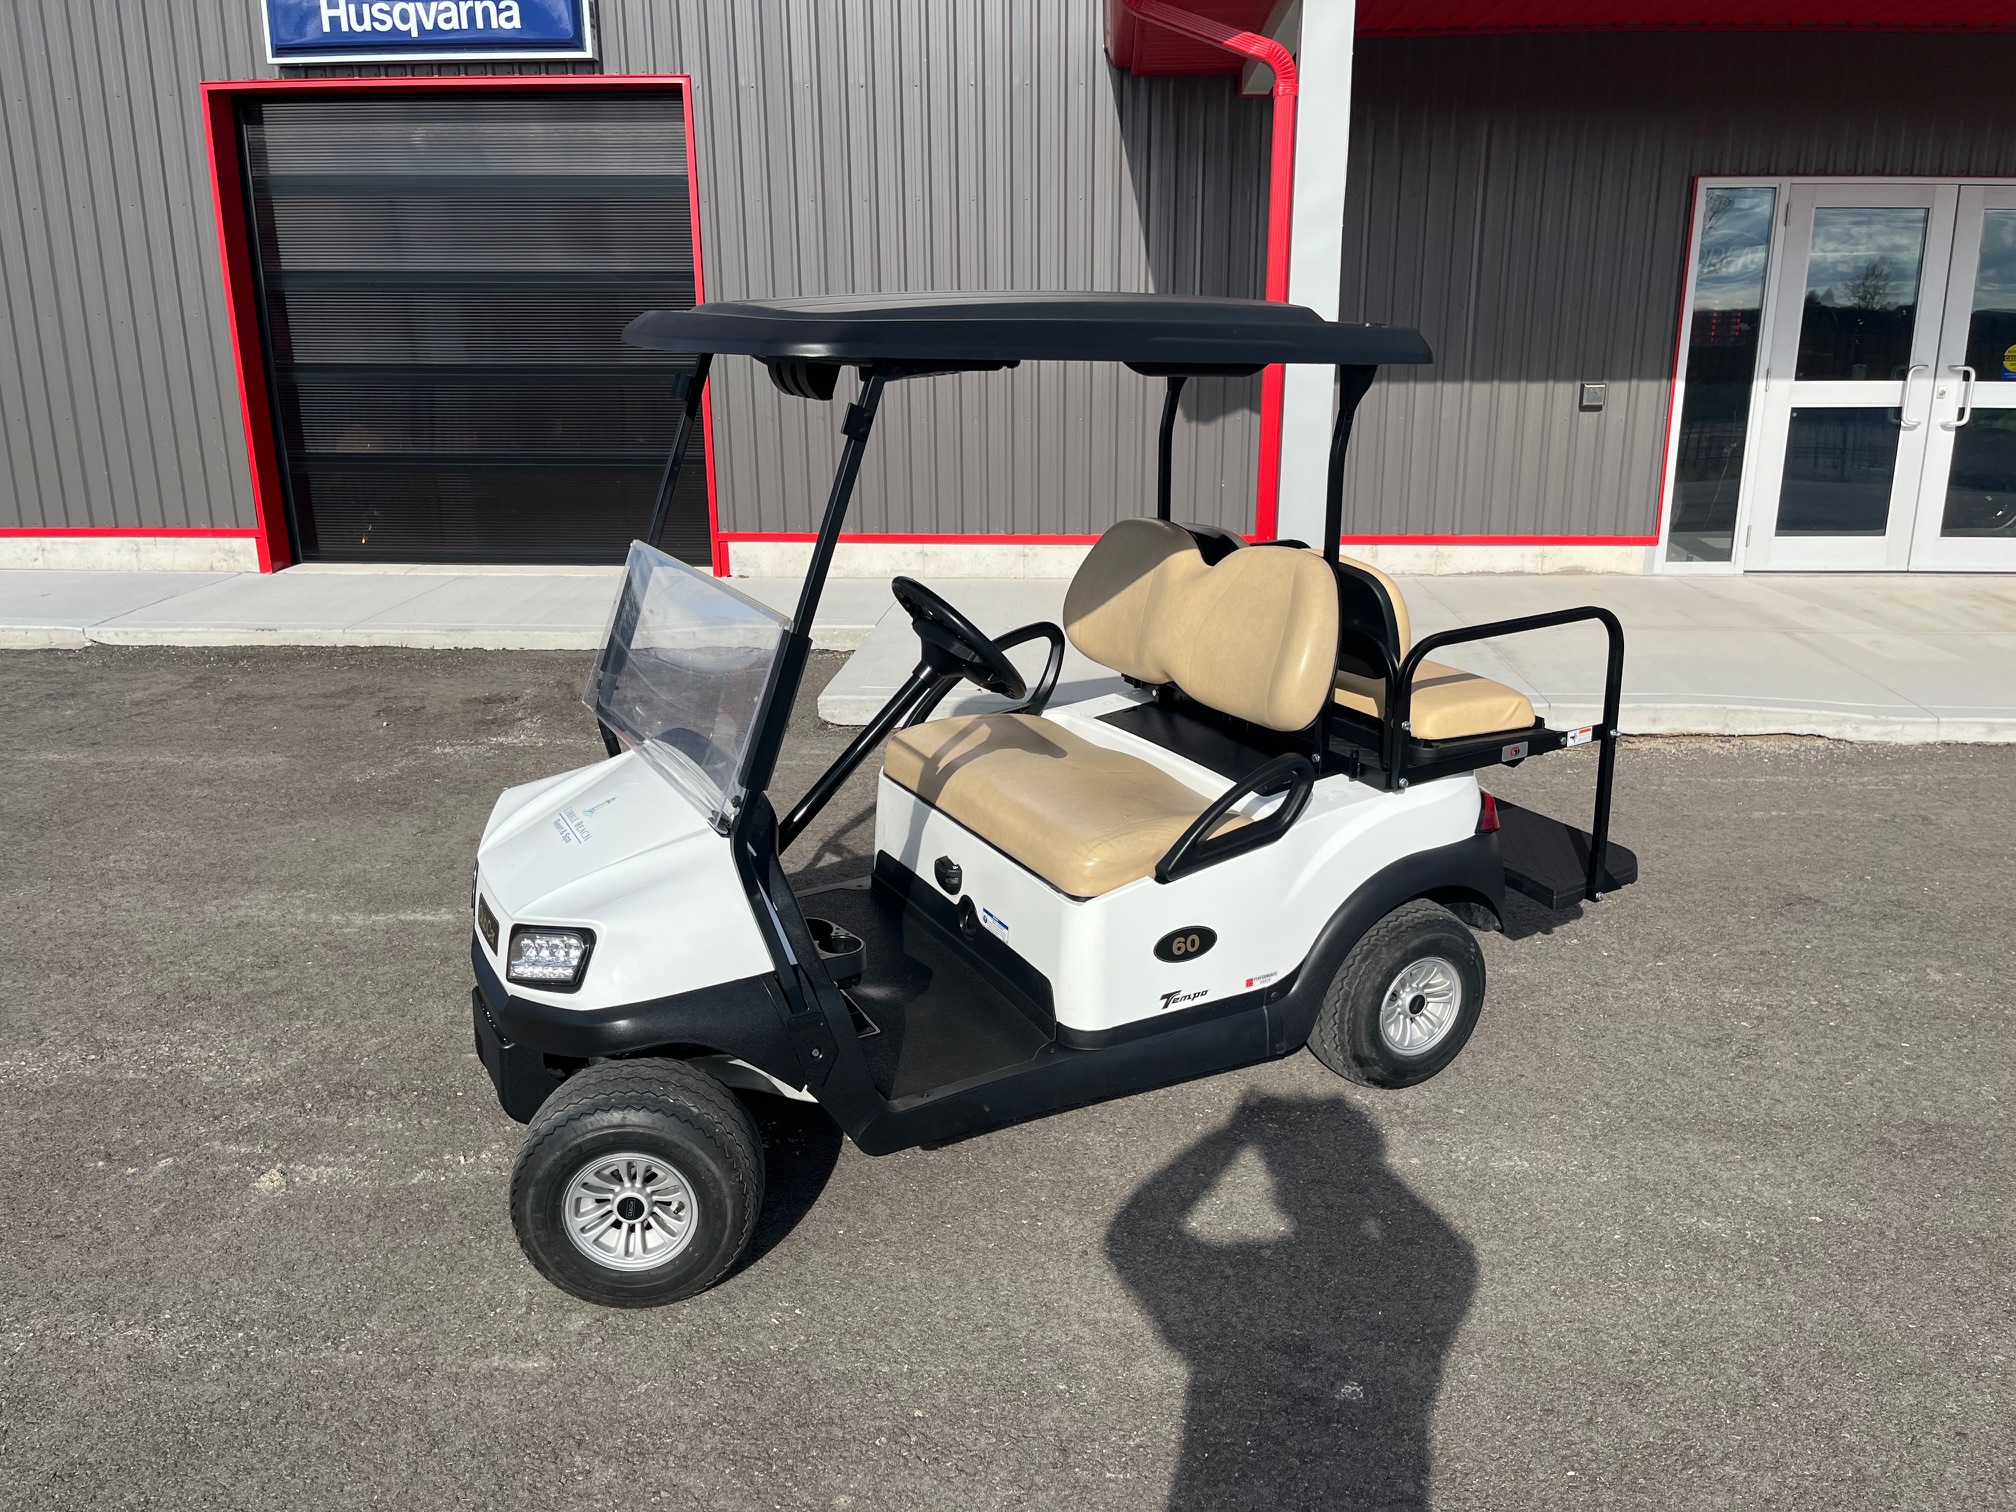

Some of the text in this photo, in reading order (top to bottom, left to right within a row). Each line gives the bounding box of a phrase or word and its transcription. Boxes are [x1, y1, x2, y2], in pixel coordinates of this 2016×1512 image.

[319, 0, 521, 37] Husqvarna
[573, 820, 592, 841] BEACH
[1172, 934, 1200, 956] 60
[1159, 989, 1209, 1010] Tempo
